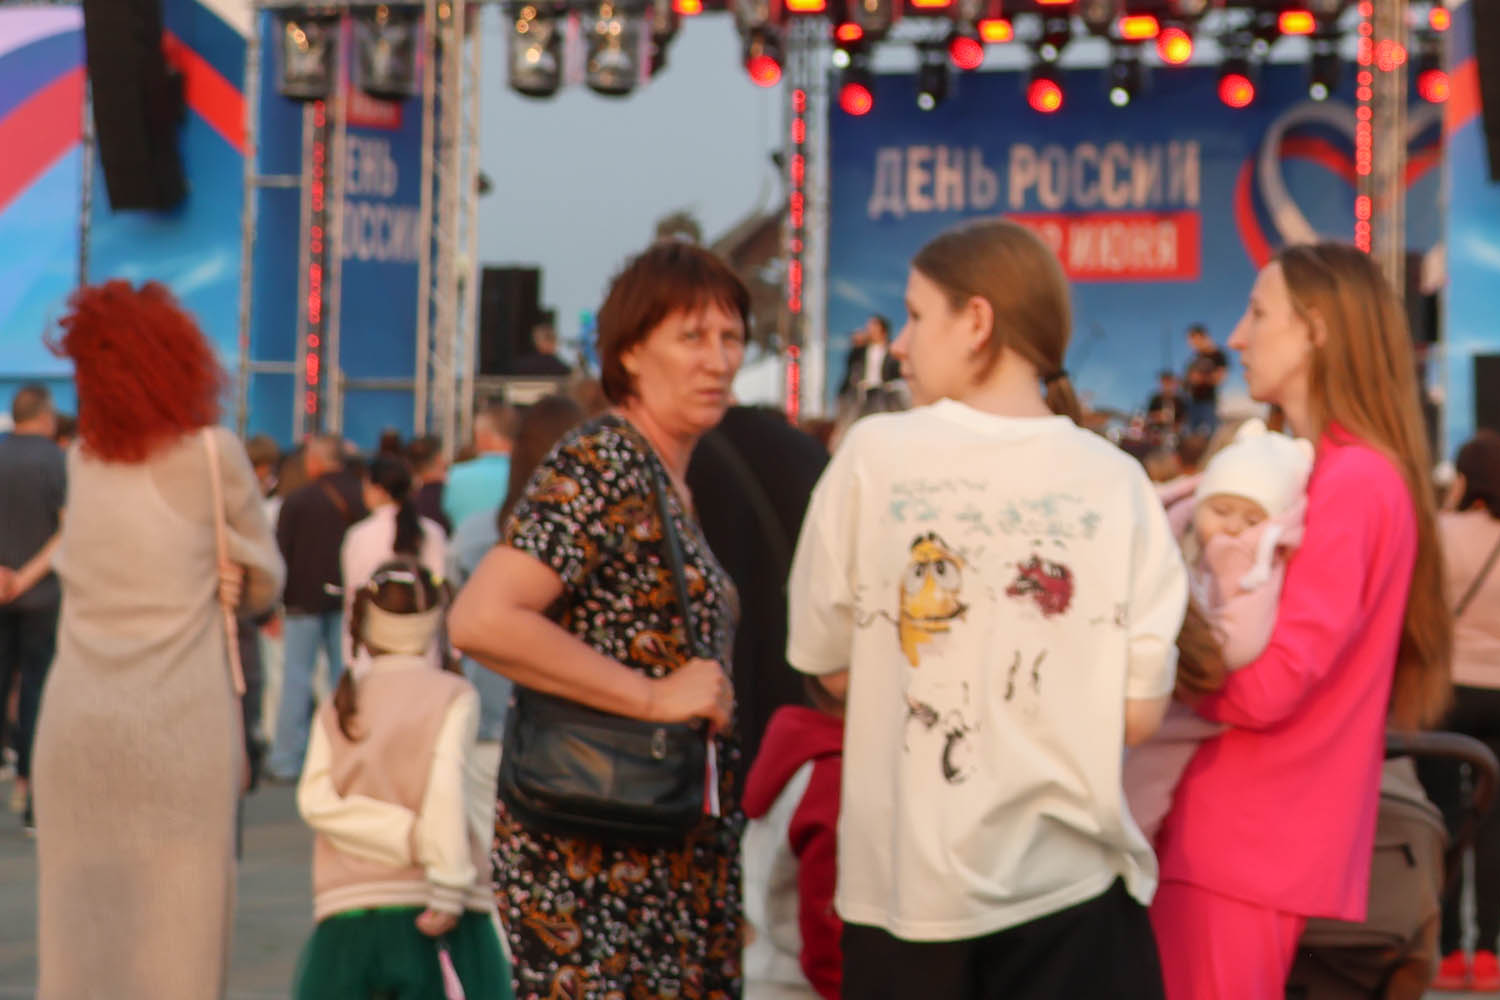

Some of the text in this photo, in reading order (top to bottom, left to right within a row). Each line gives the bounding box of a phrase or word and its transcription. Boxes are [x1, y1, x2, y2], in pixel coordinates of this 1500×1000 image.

[344, 134, 397, 197] ЕНЬ
[868, 139, 1200, 220] ДЕНЬ РОССИИ
[1069, 219, 1178, 272] ИЮНЯ
